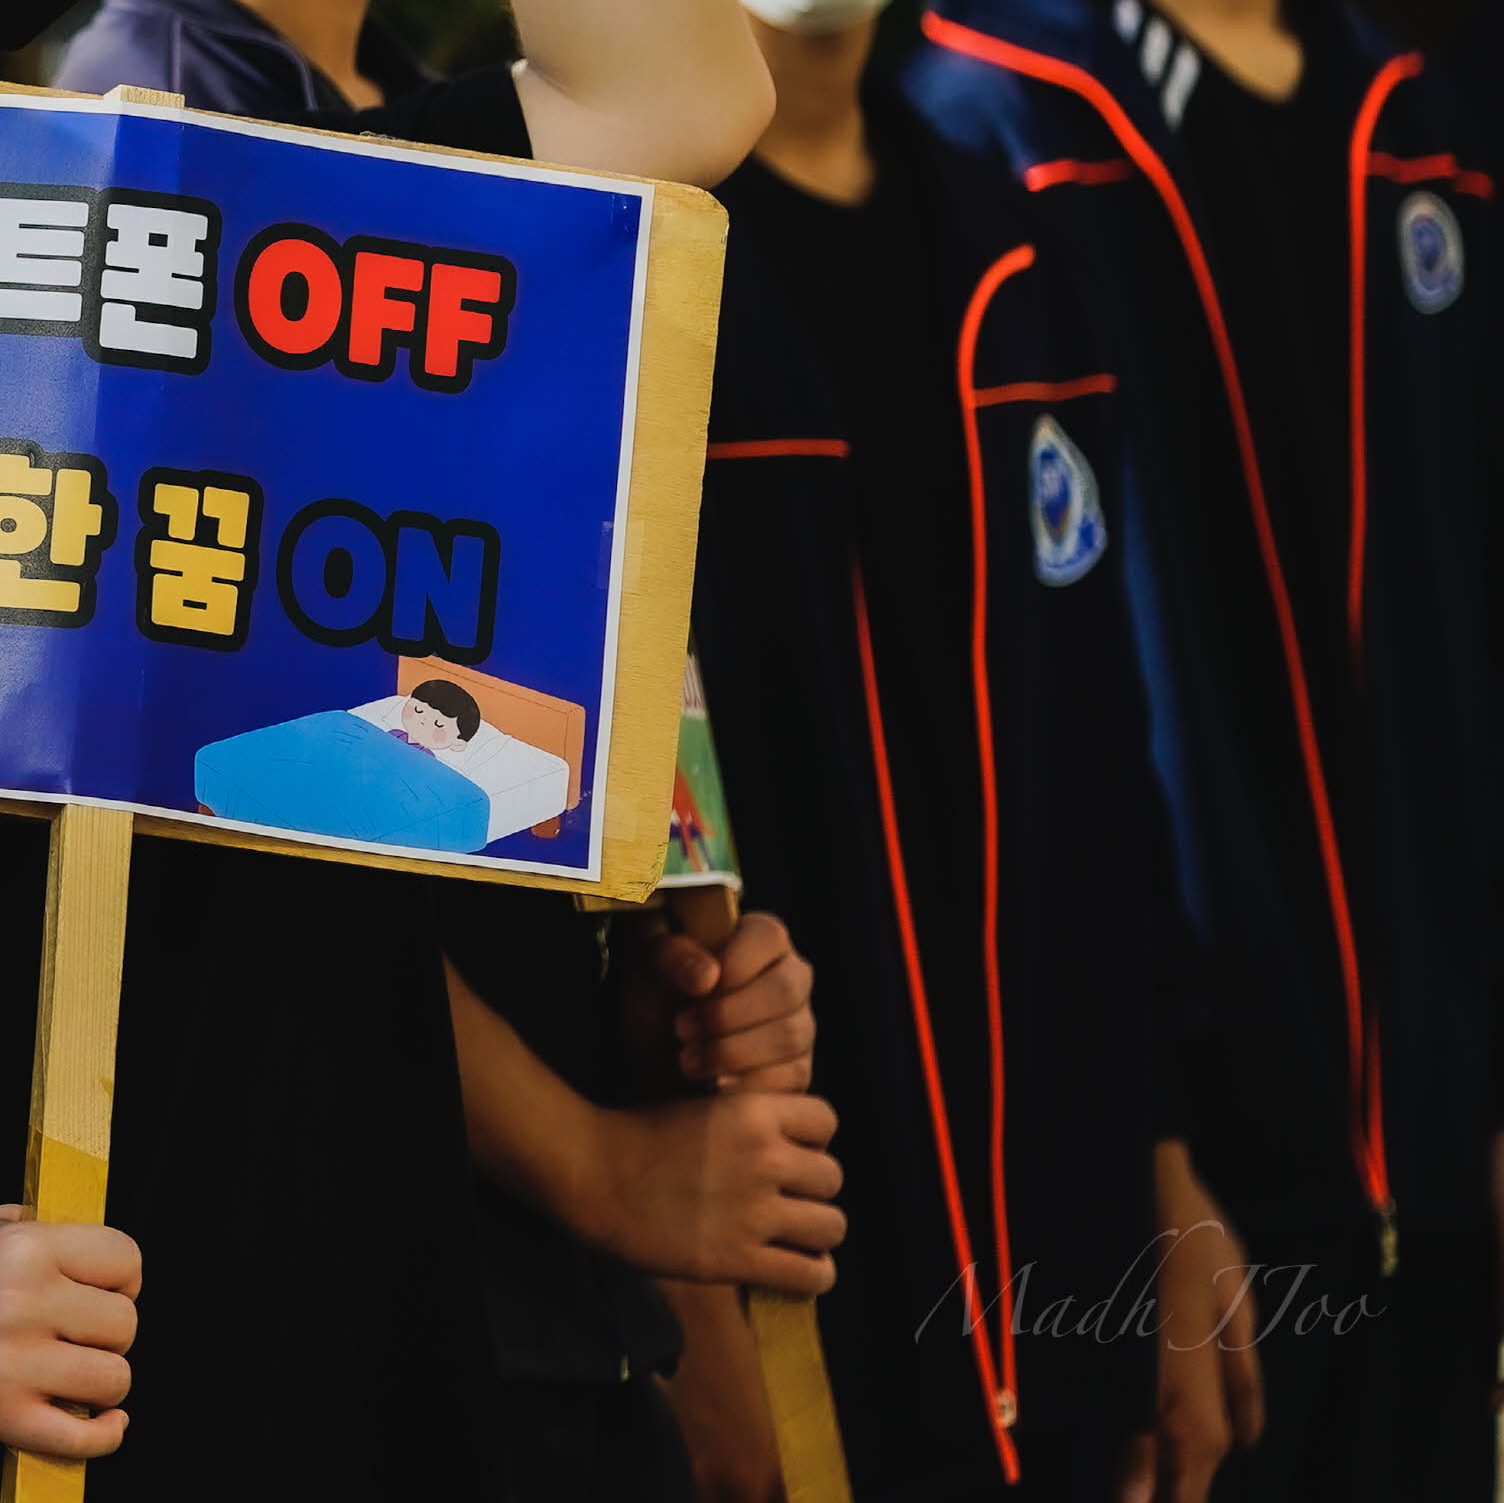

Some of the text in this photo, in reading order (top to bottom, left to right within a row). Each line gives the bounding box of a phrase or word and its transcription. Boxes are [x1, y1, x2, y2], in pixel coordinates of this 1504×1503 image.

[233, 221, 518, 394] OFF
[134, 470, 264, 653] 꿈
[277, 498, 500, 665] ON
